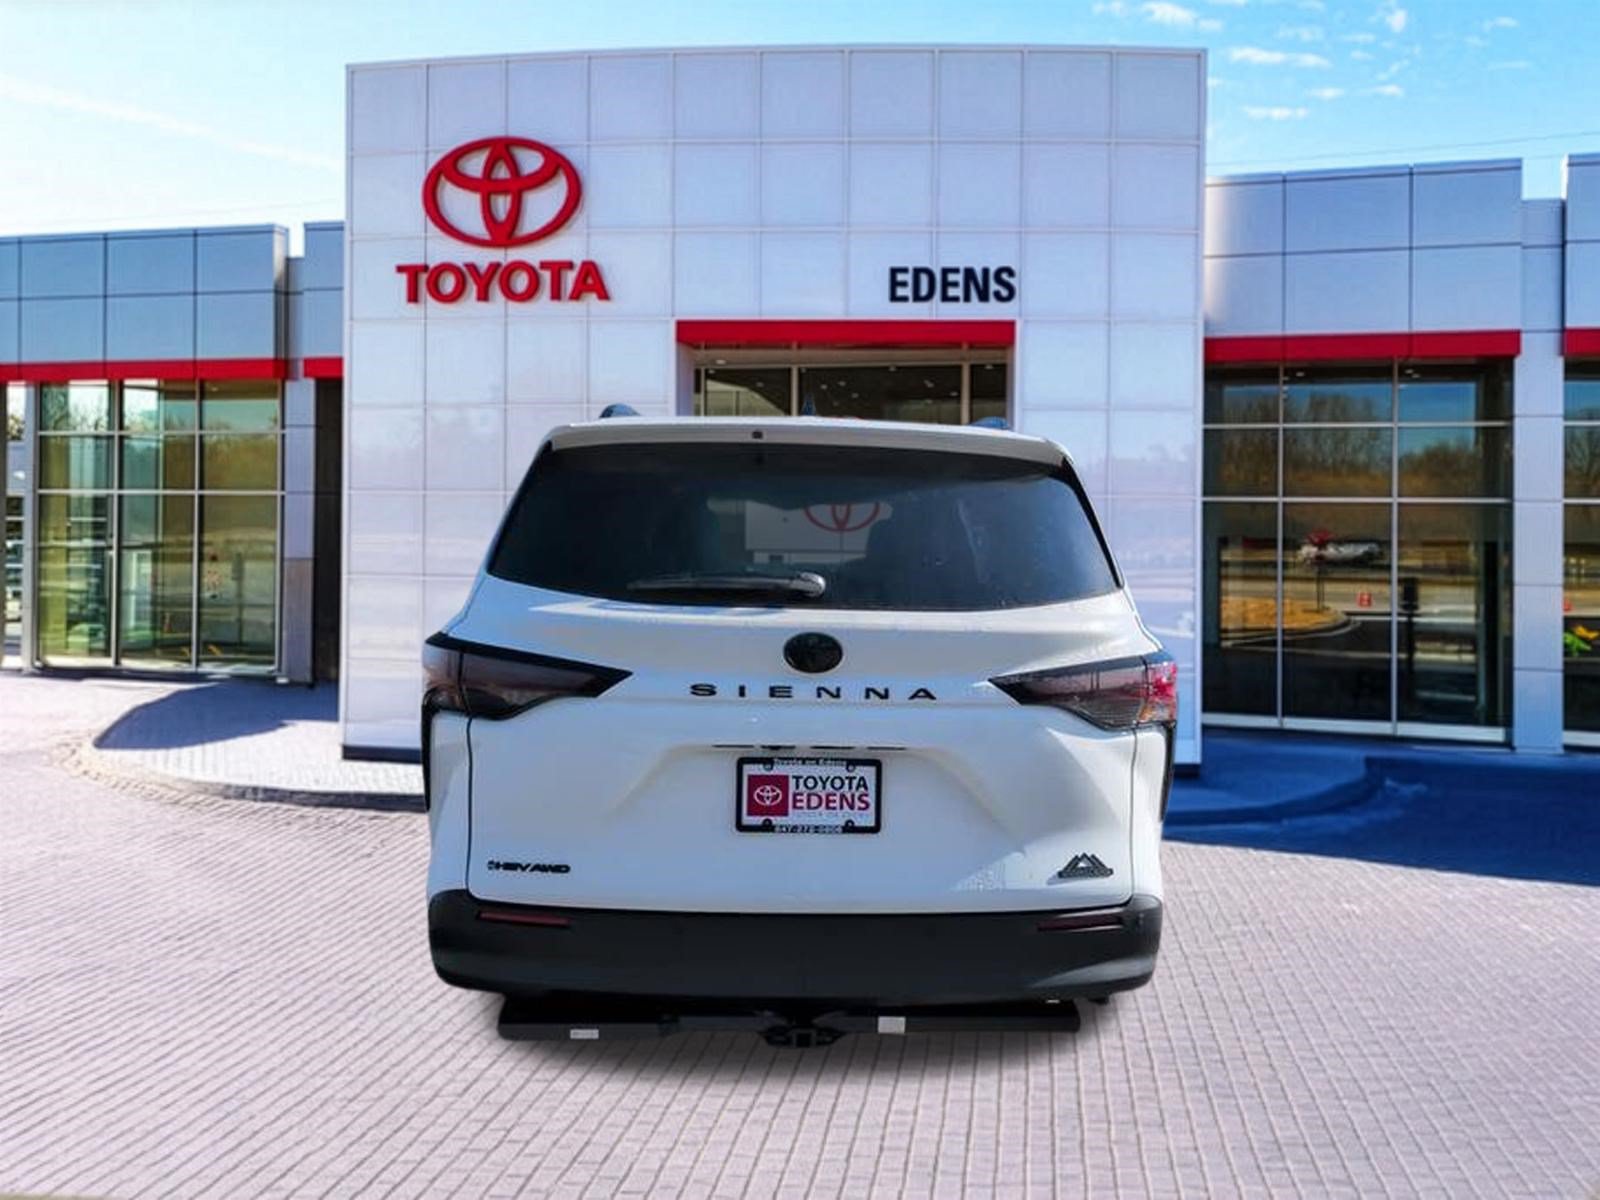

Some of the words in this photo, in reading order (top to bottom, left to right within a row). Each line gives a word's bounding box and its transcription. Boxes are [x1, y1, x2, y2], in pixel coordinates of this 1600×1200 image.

[396, 259, 610, 304] TOYOTA
[889, 265, 1016, 303] EDENS
[690, 683, 937, 700] SIENNA
[792, 775, 868, 791] TOYOTA
[792, 793, 870, 811] EDENS
